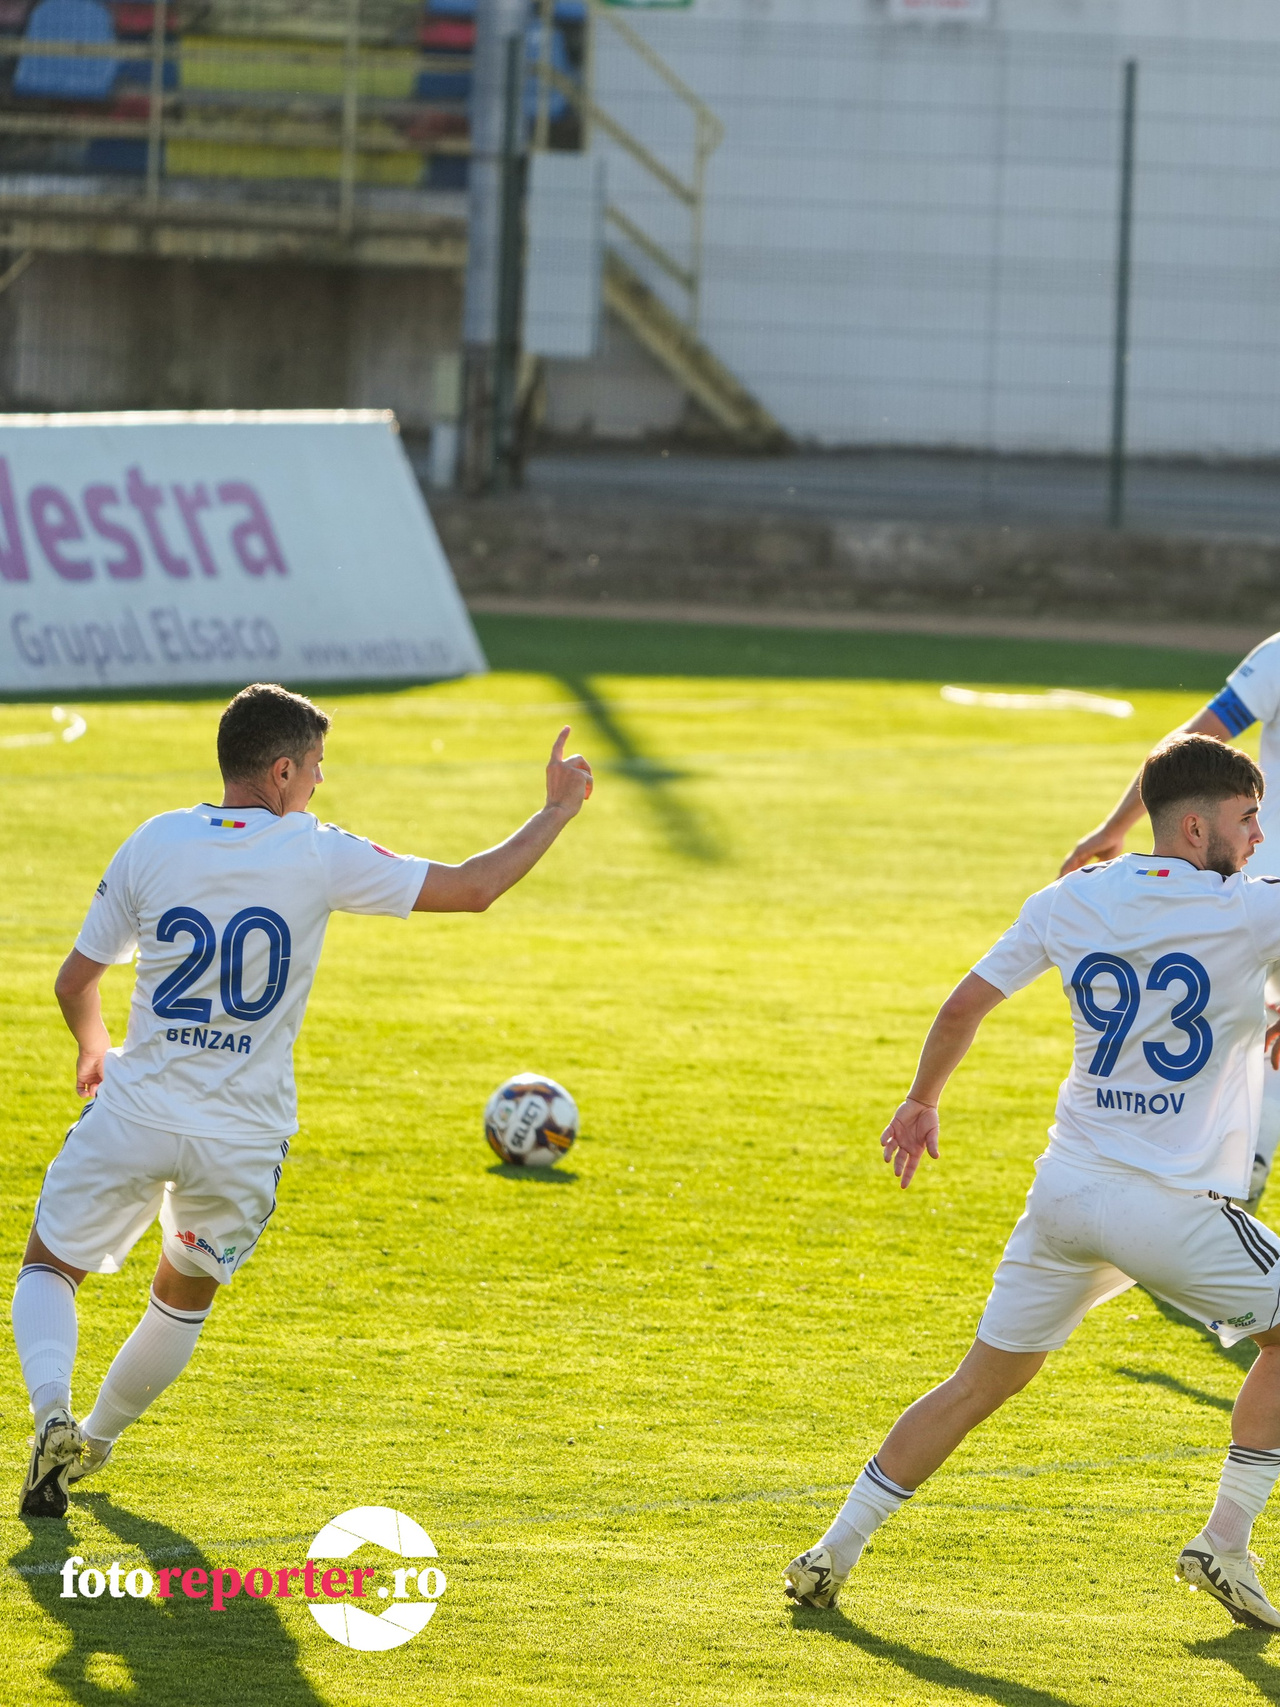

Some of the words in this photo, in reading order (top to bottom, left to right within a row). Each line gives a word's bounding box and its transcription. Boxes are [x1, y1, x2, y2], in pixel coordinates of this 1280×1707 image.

[10, 606, 151, 677] Grupul
[150, 606, 281, 664] Elsaco
[152, 906, 291, 1023] 20
[166, 1027, 252, 1054] BENZAR
[1071, 952, 1213, 1081] 93
[1096, 1087, 1186, 1115] MITROV
